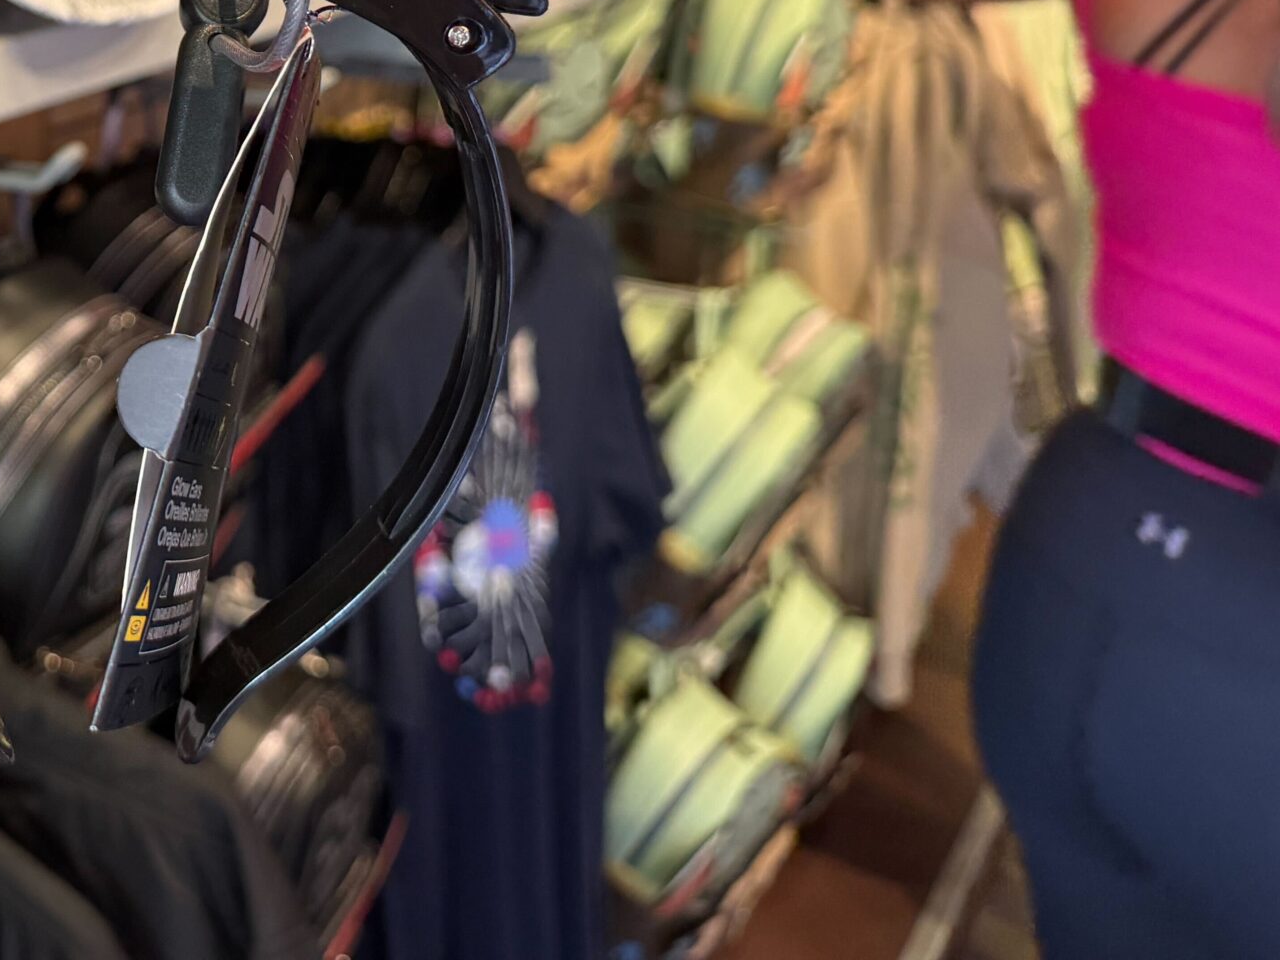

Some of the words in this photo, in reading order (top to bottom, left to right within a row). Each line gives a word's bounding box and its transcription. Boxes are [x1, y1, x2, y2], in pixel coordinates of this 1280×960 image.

[171, 476, 191, 498] Glow
[189, 480, 203, 499] Ears
[157, 526, 181, 552] Orejas
